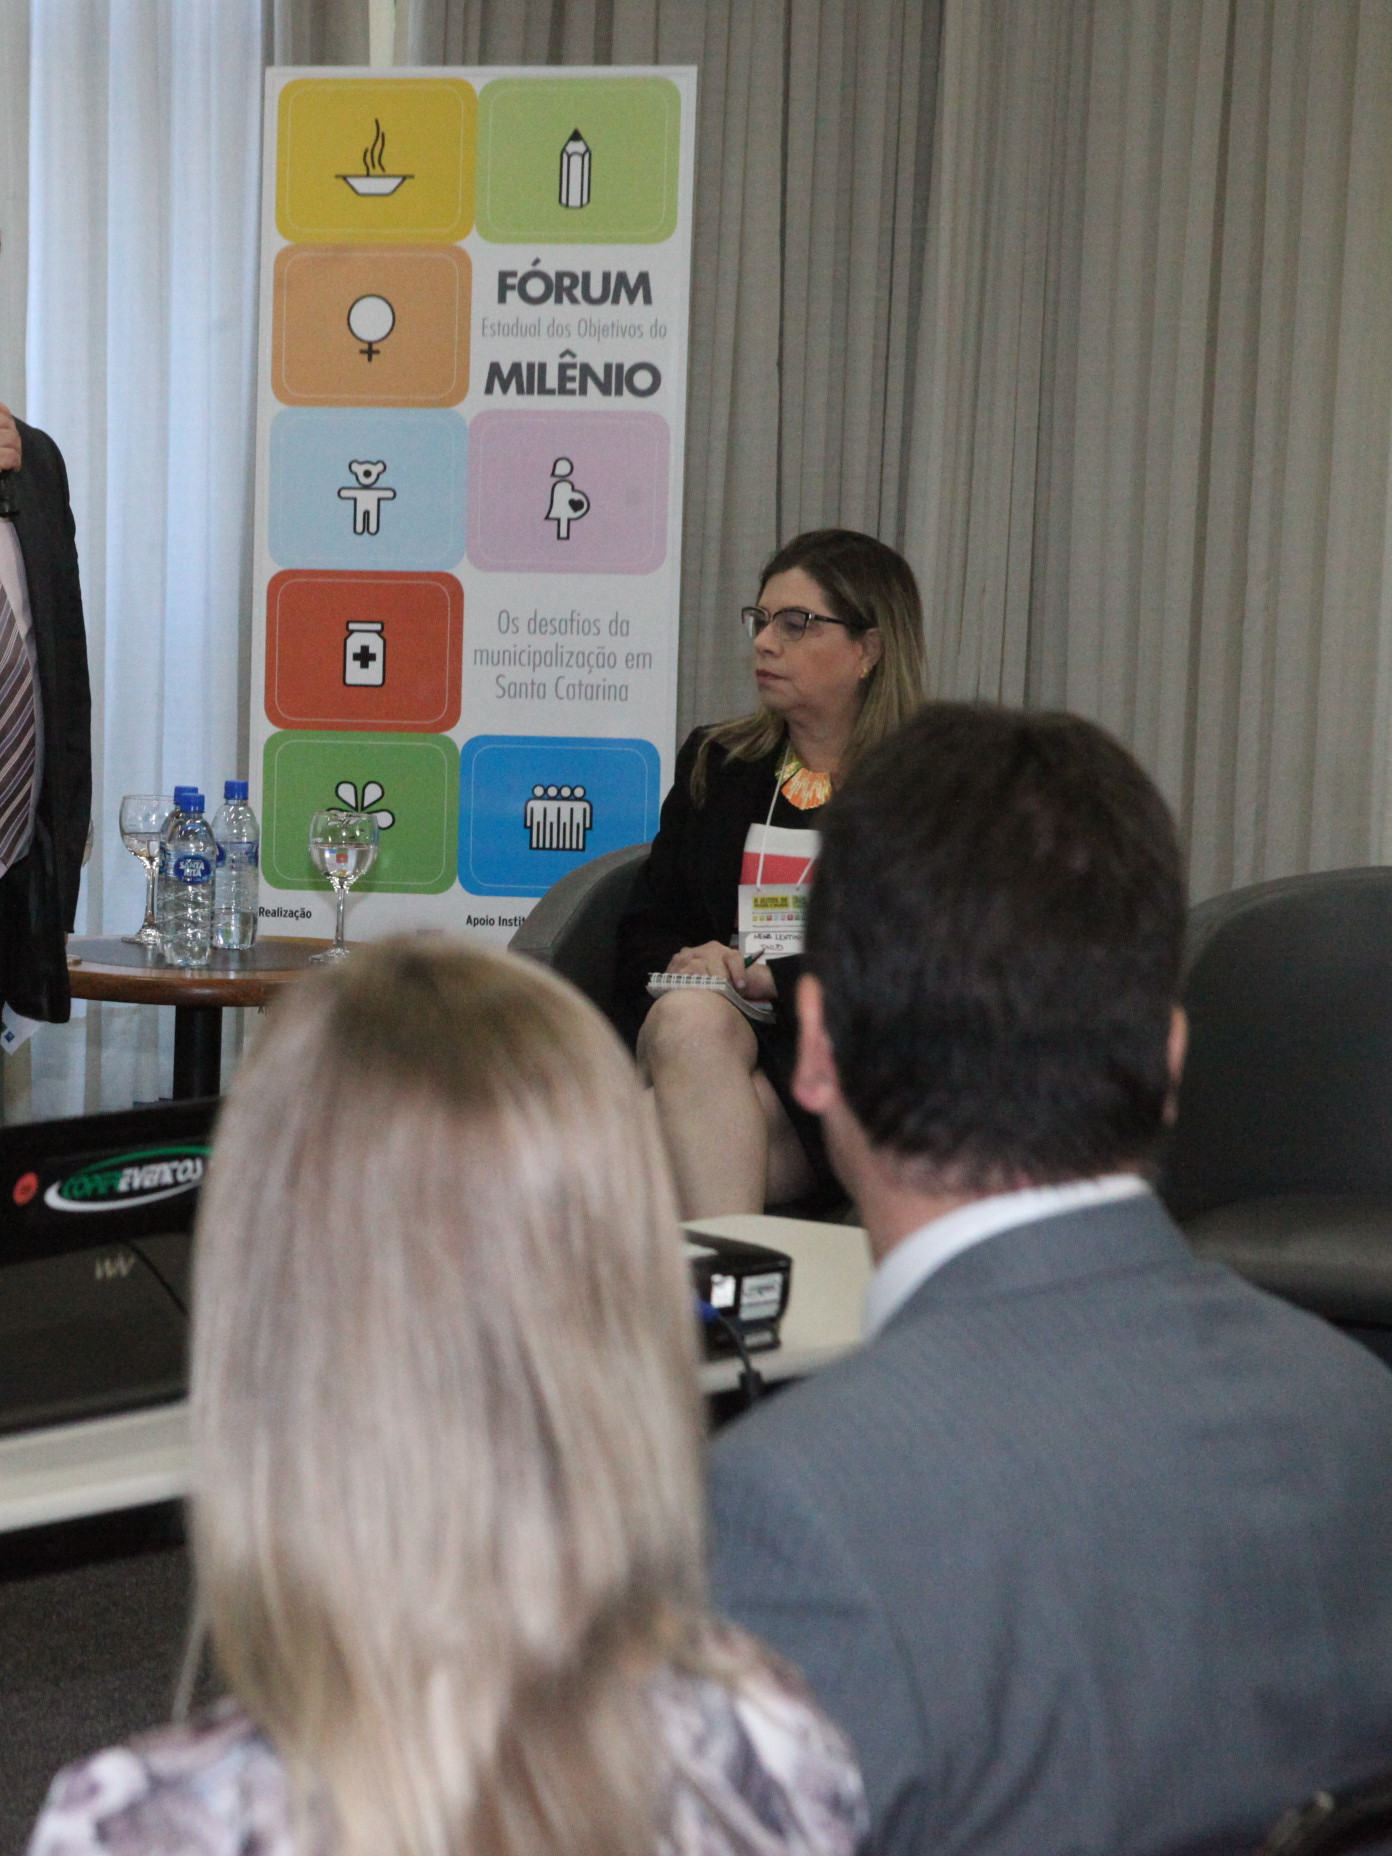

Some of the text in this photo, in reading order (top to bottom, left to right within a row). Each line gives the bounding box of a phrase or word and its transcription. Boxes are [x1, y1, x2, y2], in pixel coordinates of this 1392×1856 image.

[497, 257, 652, 305] FÓRUM
[481, 317, 668, 342] Estadual dos Objetivos do
[484, 348, 662, 398] MILÊNIO
[497, 609, 630, 637] Os desafios da
[473, 643, 652, 674] municipalização em
[495, 674, 629, 702] Santa Catarina
[258, 906, 312, 921] Realização
[466, 914, 495, 928] Apoio
